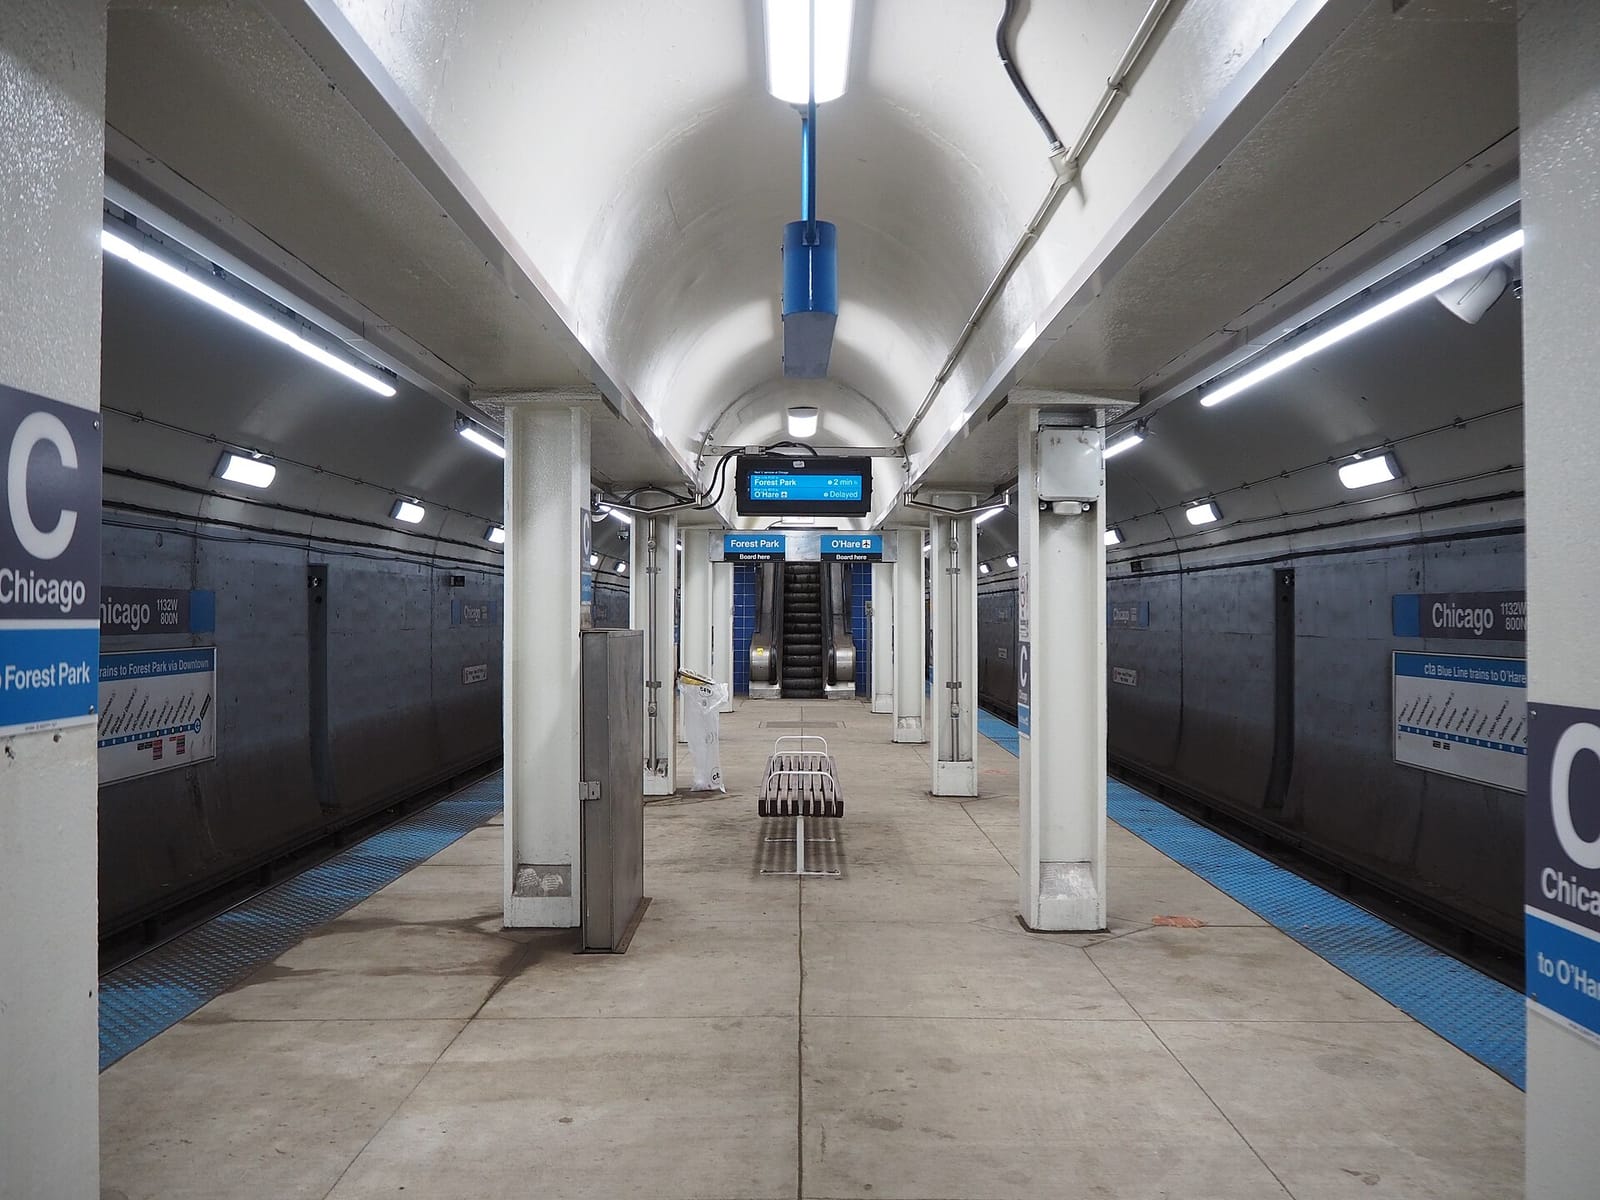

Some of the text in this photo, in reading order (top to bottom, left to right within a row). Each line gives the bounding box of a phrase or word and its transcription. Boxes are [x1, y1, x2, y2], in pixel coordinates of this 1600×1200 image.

[7, 411, 78, 560] C
[780, 478, 797, 486] Park
[833, 478, 839, 486] 2
[839, 478, 853, 486] min
[829, 490, 858, 500] Delayed
[730, 539, 780, 548] Forest Park
[831, 539, 861, 548] O'Hare
[0, 568, 86, 613] Chicago
[157, 599, 178, 611] 1132W
[1500, 602, 1527, 615] 1132W
[160, 612, 178, 625] 800N
[1432, 602, 1494, 635] Chicago
[1505, 617, 1527, 631] 800N
[99, 659, 209, 678] rains to Forest Park via Downtown
[1020, 645, 1028, 688] C
[1424, 662, 1527, 684] cta Blue Line trains to O'Hare
[5, 664, 56, 691] Forest
[58, 661, 90, 687] Park
[1537, 951, 1554, 977] to
